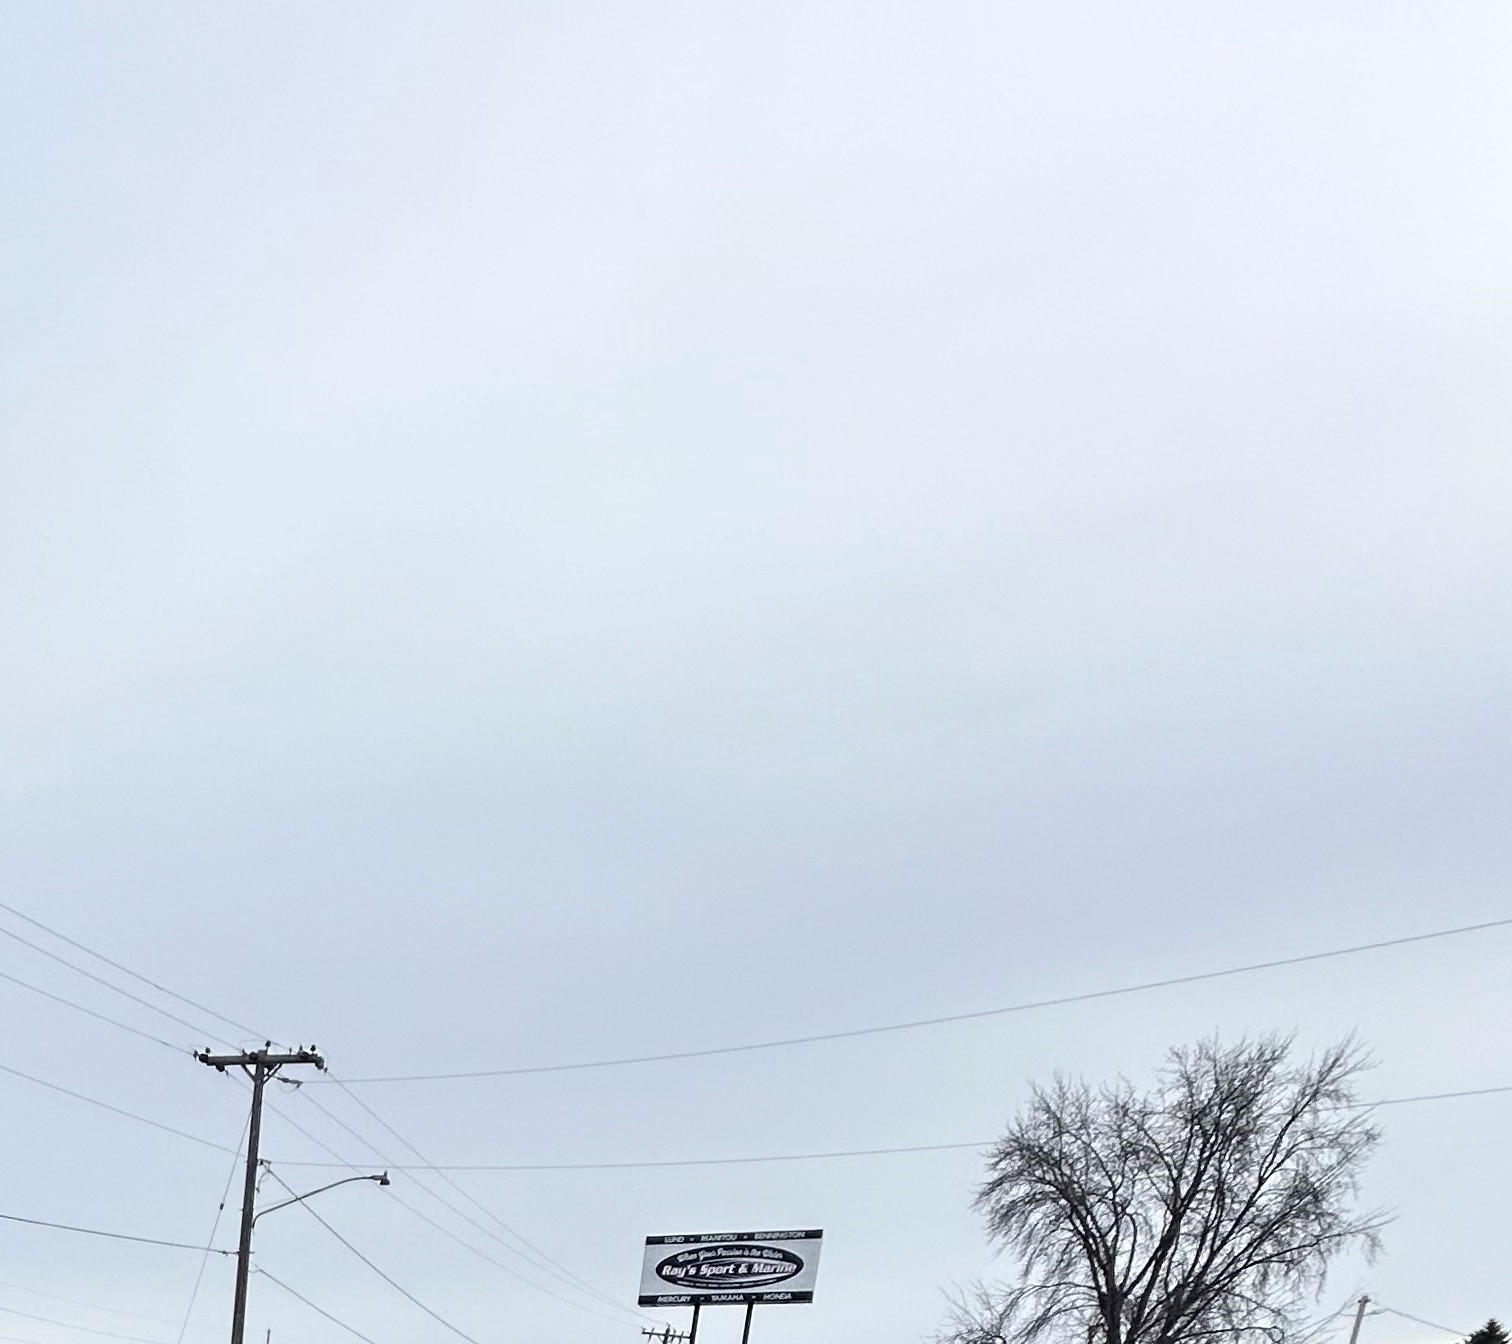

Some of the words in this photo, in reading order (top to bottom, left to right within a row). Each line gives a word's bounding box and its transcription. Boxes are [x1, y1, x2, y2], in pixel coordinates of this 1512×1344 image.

[661, 1264, 697, 1278] Ray's
[699, 1264, 735, 1277] Sport
[738, 1263, 749, 1274] &
[751, 1261, 798, 1274] Marine
